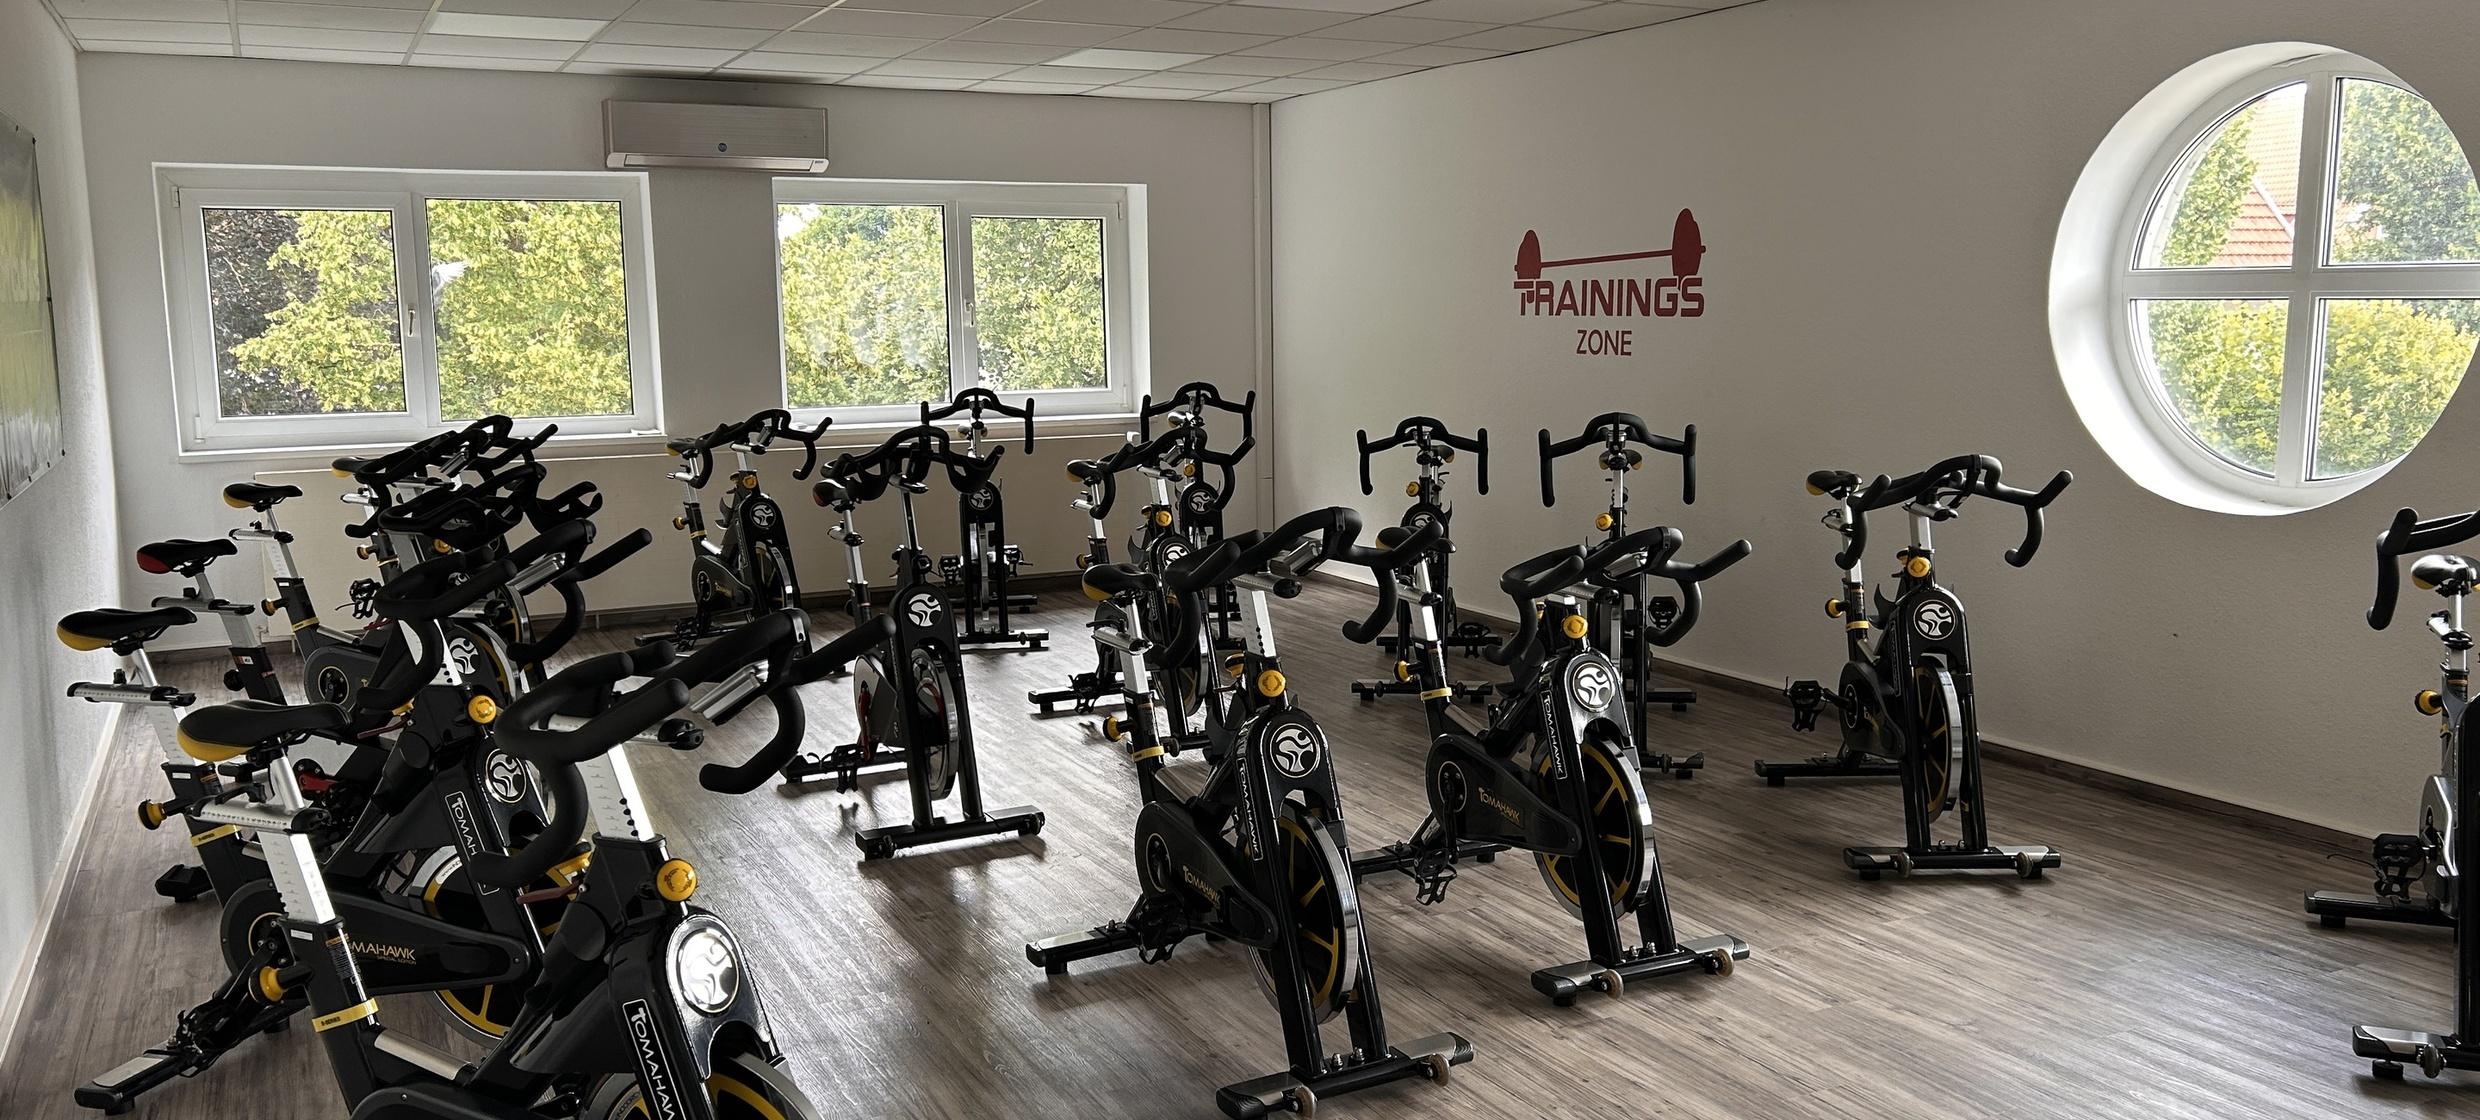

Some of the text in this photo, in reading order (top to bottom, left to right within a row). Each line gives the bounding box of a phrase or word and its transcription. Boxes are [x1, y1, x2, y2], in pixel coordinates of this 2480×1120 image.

[1513, 277, 1705, 317] TRAININGS
[1576, 329, 1632, 356] ZONE
[1543, 694, 1564, 774] TOMAHAWK
[1240, 763, 1259, 853] TOMAHAWK
[1478, 787, 1520, 823] TOMAHAWK
[451, 797, 478, 856] TOMAH
[1183, 865, 1221, 905] TOMAHAWK
[351, 941, 416, 961] MAHAWK
[631, 1007, 676, 1120] TOMAHAW
